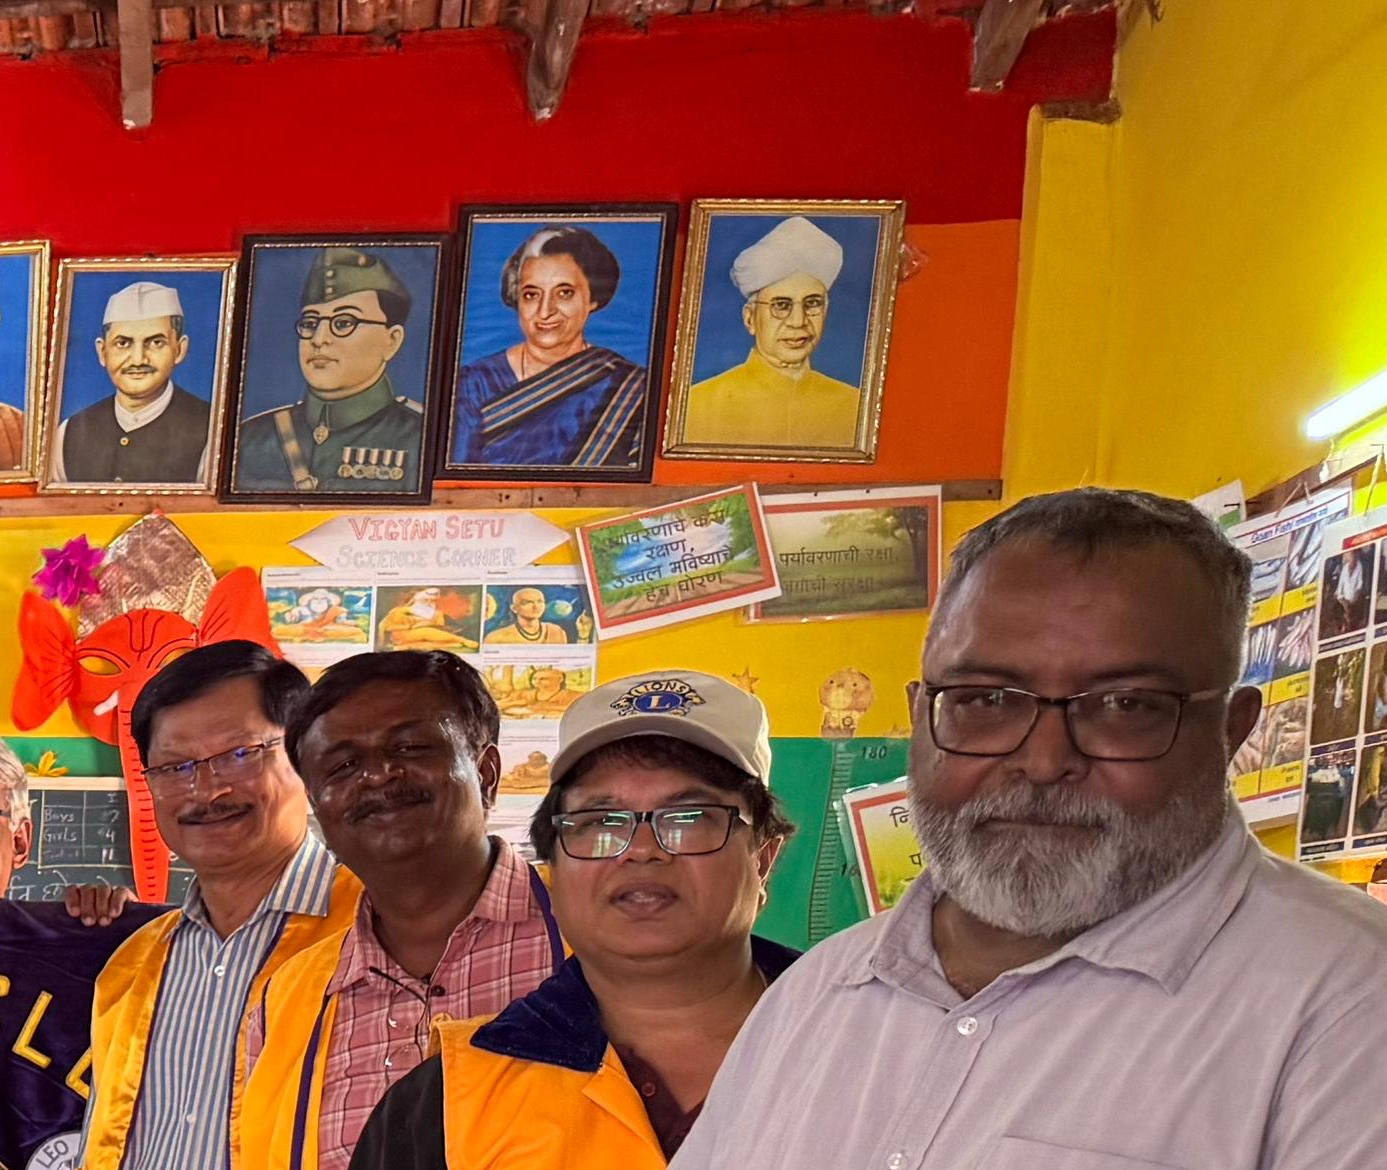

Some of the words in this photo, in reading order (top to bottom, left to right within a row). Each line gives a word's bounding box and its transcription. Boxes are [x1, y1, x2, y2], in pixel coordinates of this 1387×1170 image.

[348, 516, 437, 542] VIGYAN
[445, 515, 505, 540] SETU
[436, 547, 517, 567] CORNER
[633, 681, 688, 694] LIONS
[648, 694, 670, 709] L
[861, 745, 887, 759] 180
[44, 828, 77, 844] Girls
[35, 1139, 70, 1169] LEO
